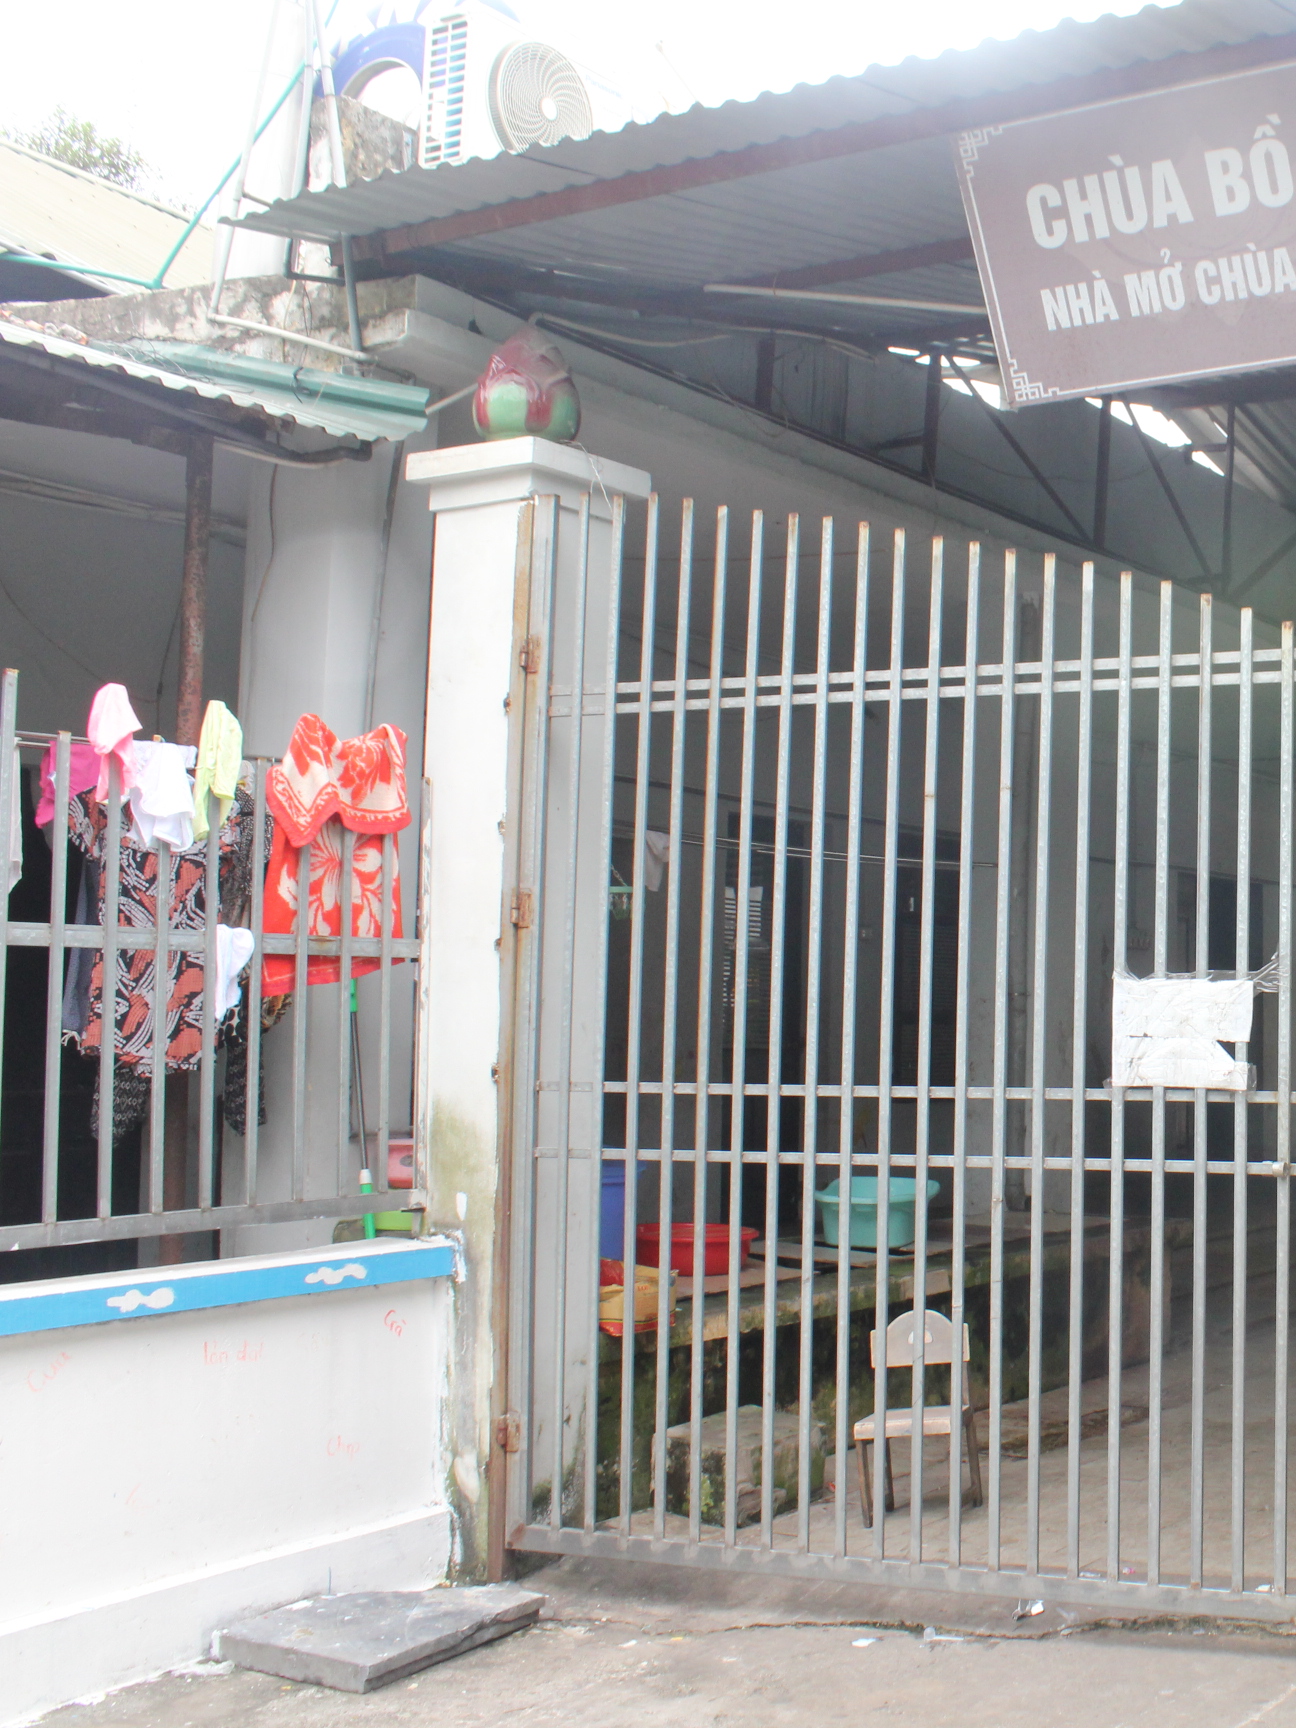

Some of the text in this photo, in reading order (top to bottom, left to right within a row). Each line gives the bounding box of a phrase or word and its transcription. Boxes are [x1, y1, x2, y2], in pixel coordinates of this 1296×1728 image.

[1026, 154, 1194, 249] CHÙA
[1204, 113, 1294, 217] BỒ
[1040, 270, 1119, 331] NHÀ
[1124, 247, 1187, 317] MỞ
